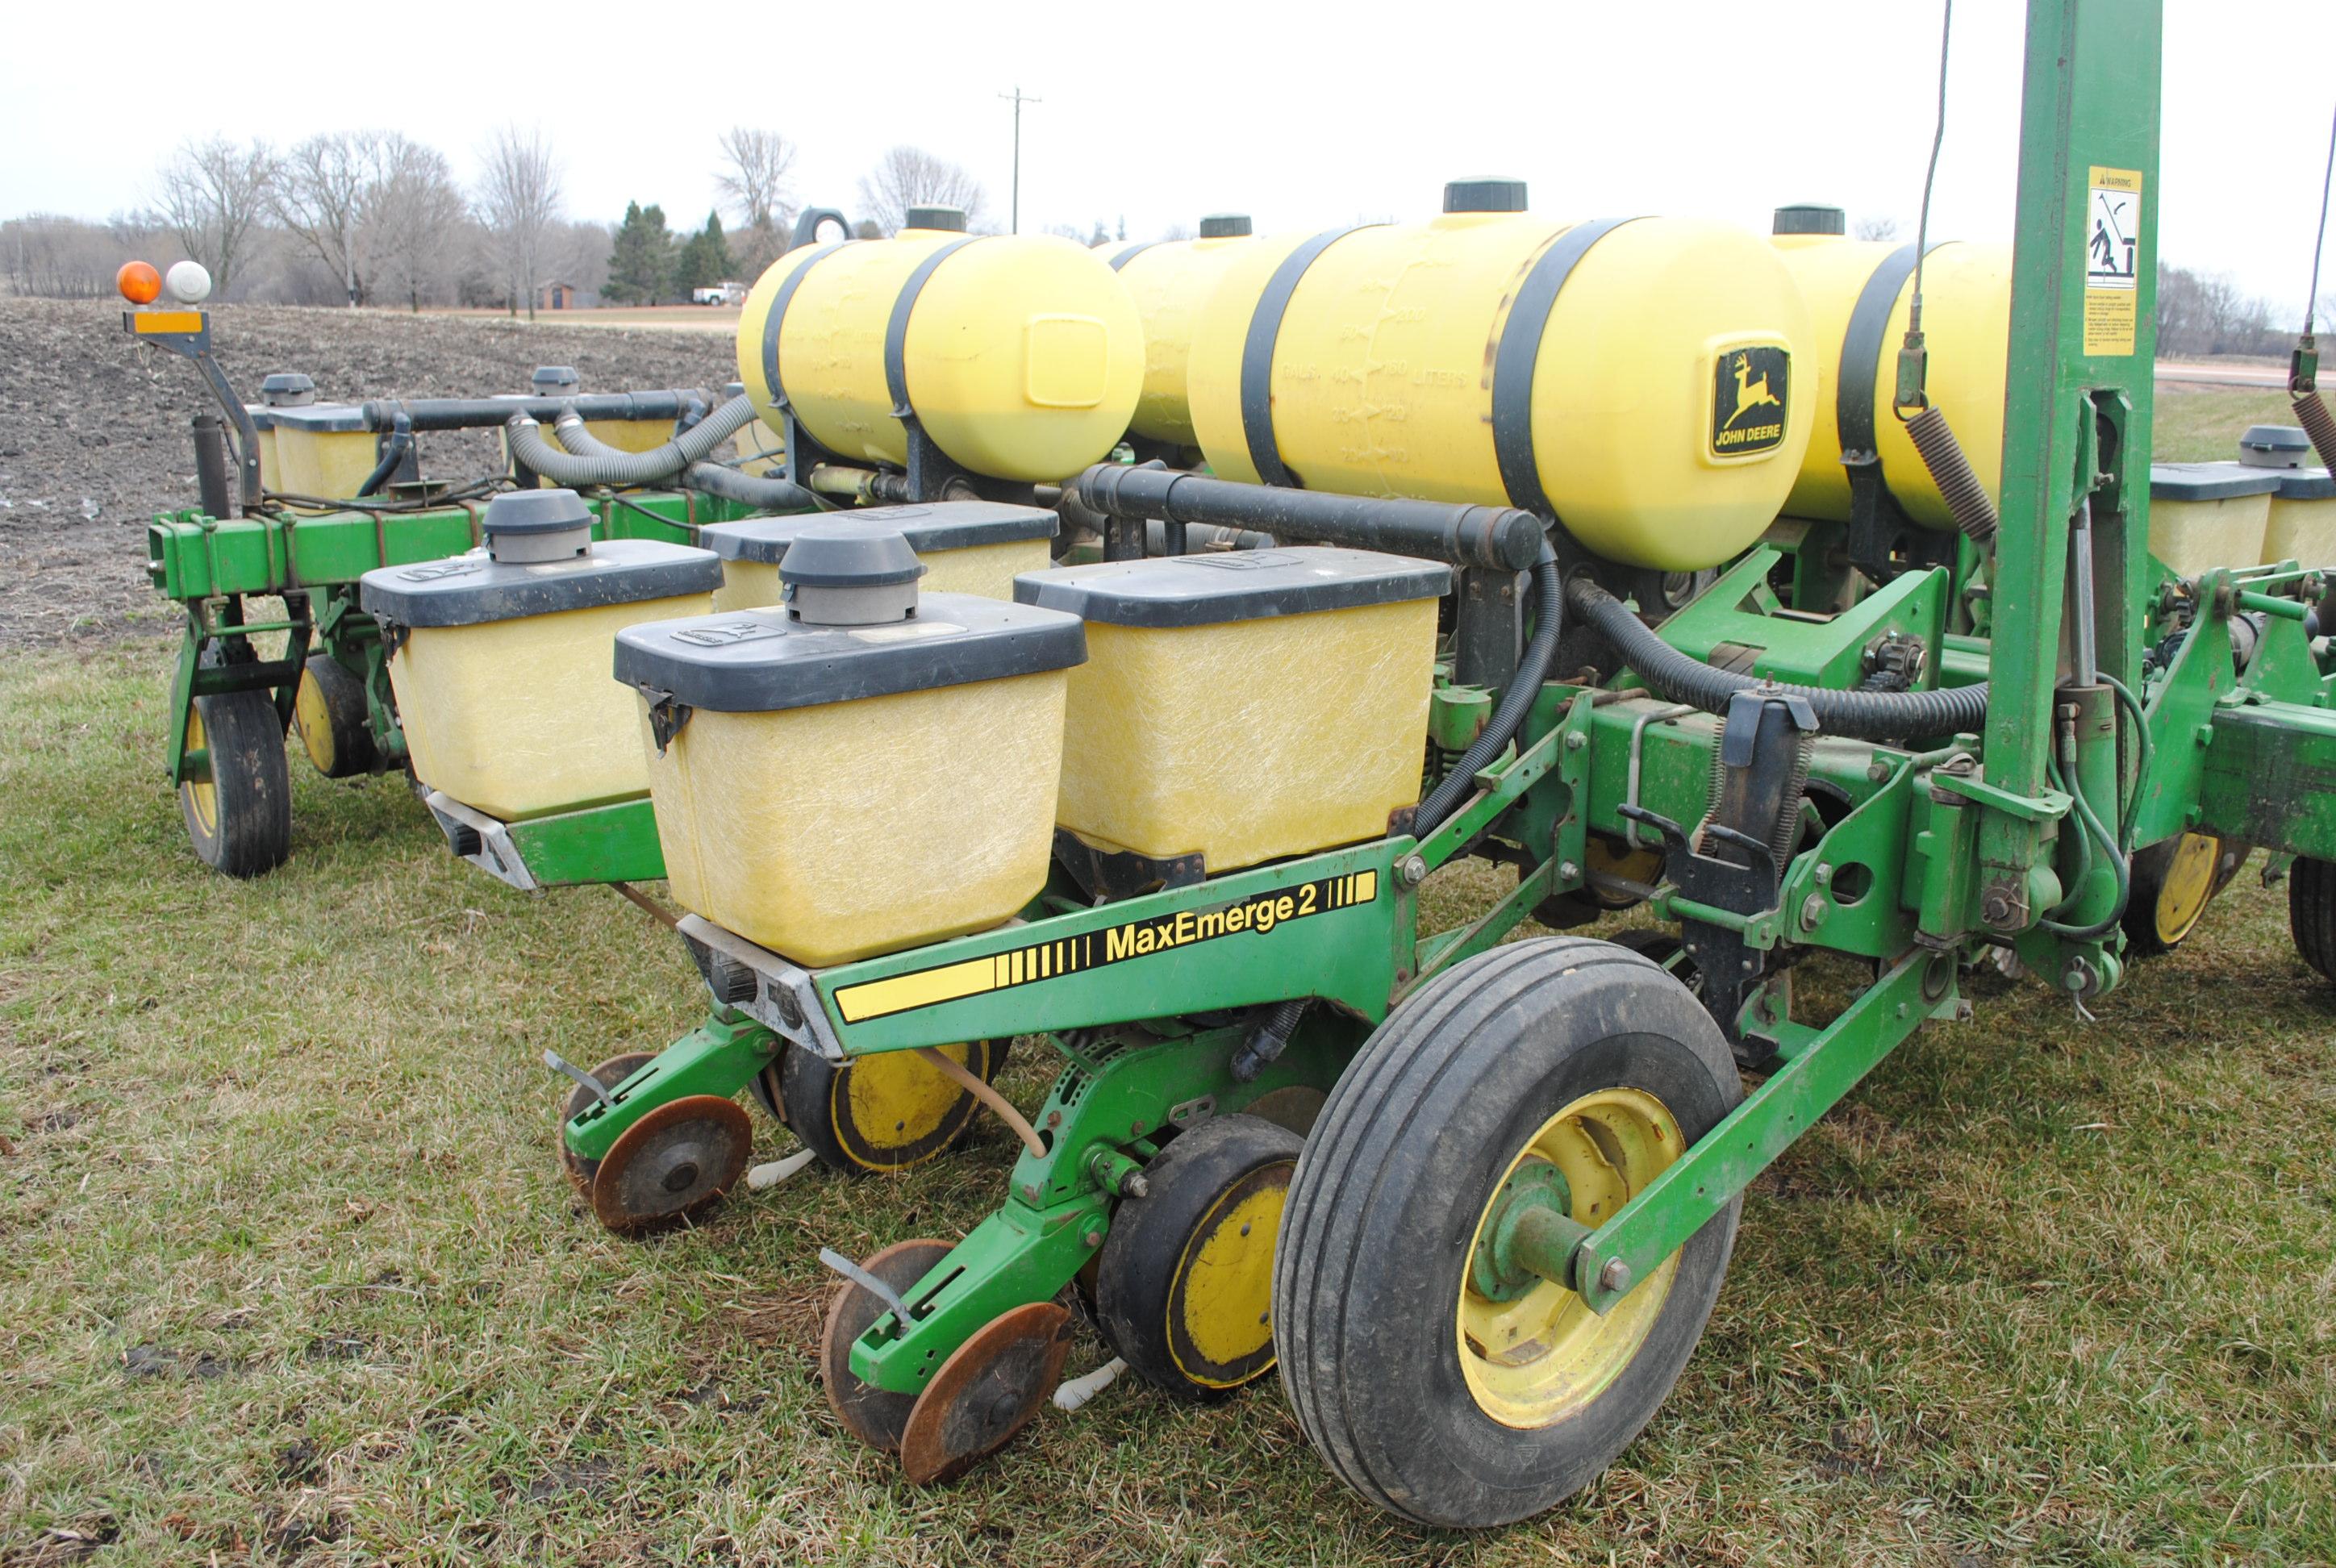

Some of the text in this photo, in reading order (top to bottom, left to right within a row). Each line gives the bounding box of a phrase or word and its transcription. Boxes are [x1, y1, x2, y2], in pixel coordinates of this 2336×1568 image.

[2106, 177, 2131, 187] WARNING
[1412, 368, 1469, 388] LITERS
[1716, 423, 1781, 446] JOHN DEERE
[1106, 883, 1316, 961] MaxEmerge 2
